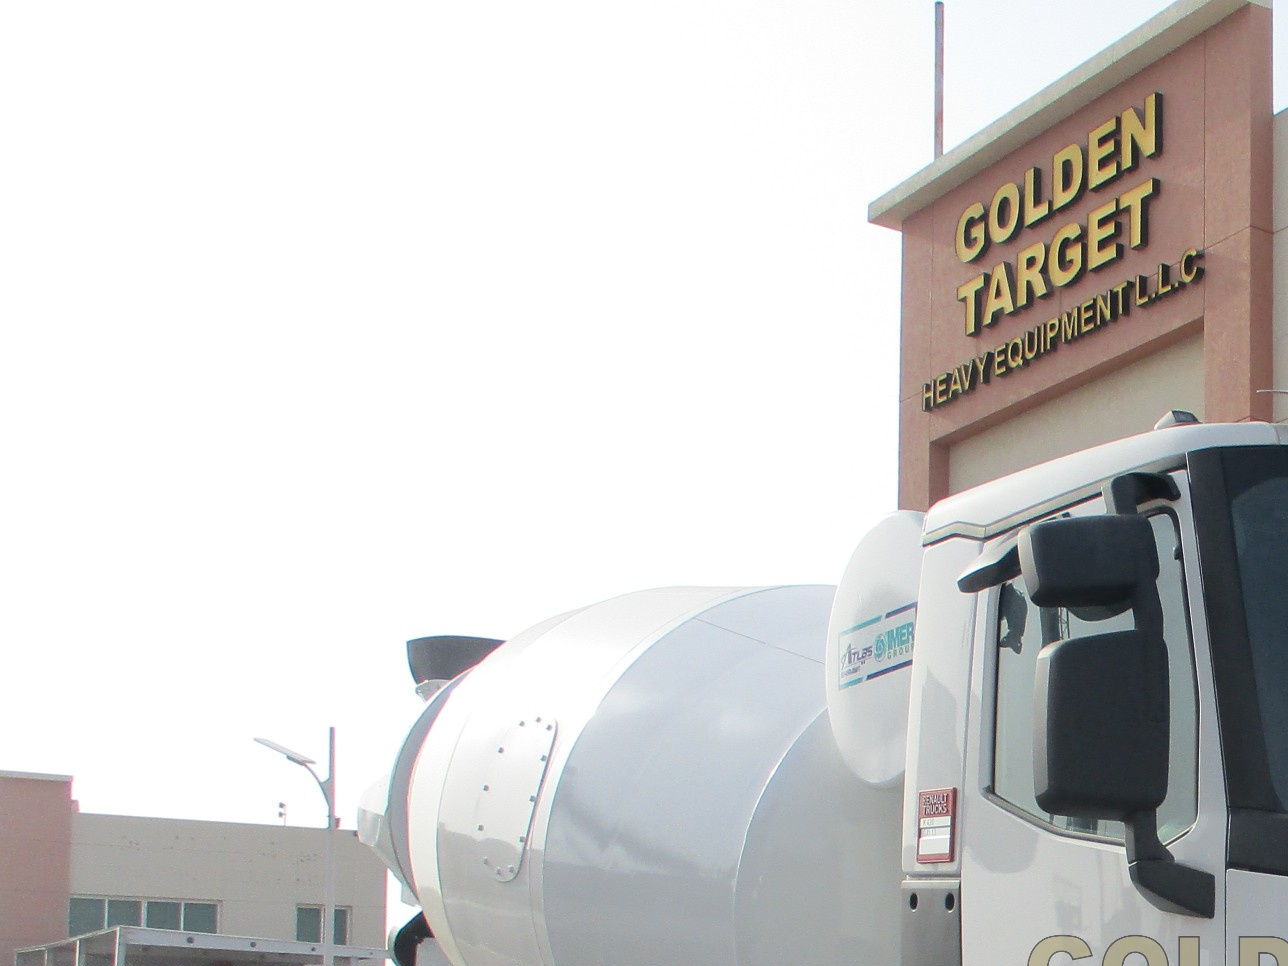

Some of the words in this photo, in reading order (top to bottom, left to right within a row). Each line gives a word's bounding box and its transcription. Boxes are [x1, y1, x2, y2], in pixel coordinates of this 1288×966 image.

[955, 91, 1161, 264] GOLDEN
[956, 177, 1159, 337] TARGET
[921, 352, 995, 412] HEAVY
[993, 281, 1132, 377] EQUIPMENT
[923, 793, 948, 806] RENAULT
[923, 803, 948, 816] TRUCKS
